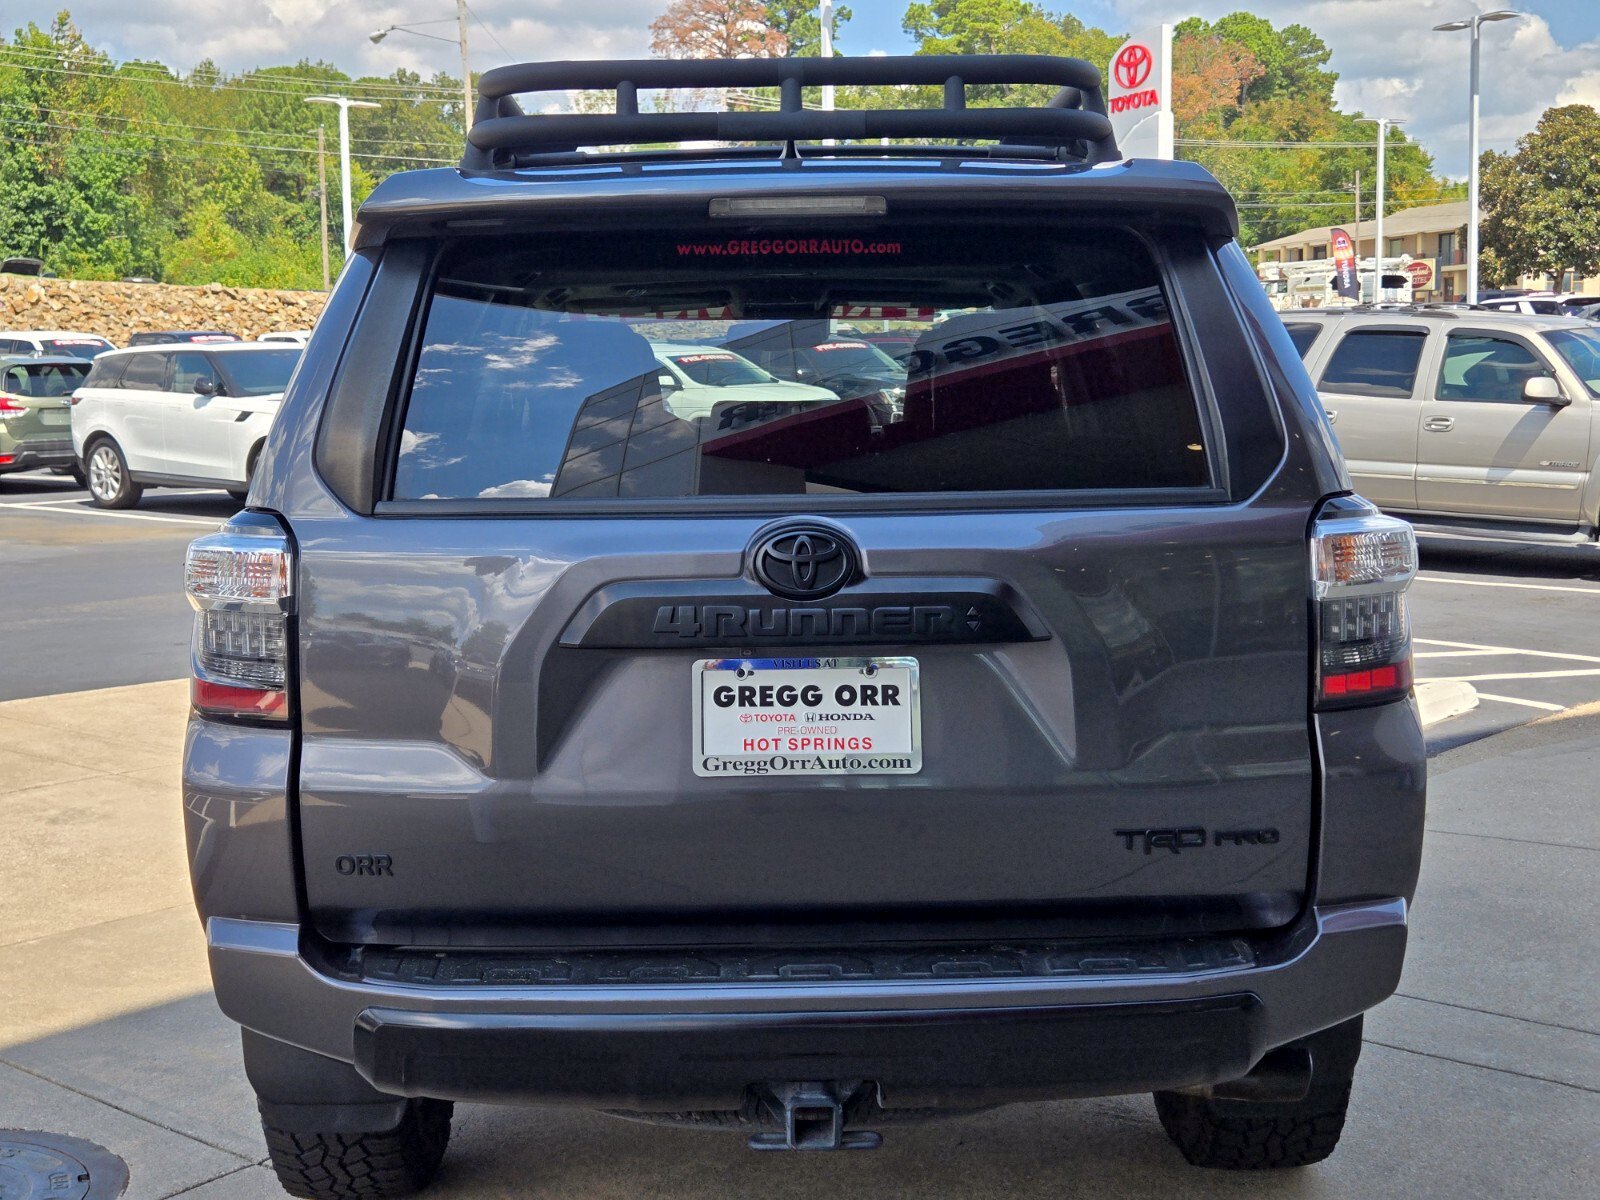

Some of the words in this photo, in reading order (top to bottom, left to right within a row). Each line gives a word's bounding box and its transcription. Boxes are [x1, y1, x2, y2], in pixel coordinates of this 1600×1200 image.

[1108, 89, 1159, 113] TOYOTA
[676, 239, 901, 255] www.GREGGORRAUTO.com
[823, 658, 840, 668] AT
[712, 685, 823, 708] GREGG
[834, 684, 901, 707] ORR
[754, 713, 796, 722] TOYOTA
[818, 712, 876, 721] HONDA
[777, 725, 837, 735] PRE-OWNED
[743, 737, 782, 752] HOT
[788, 737, 873, 751] SPRINGS
[702, 754, 913, 775] GreggOrrAuto.com
[1114, 826, 1206, 855] TRD
[1213, 829, 1280, 847] PRO
[335, 853, 394, 877] ORR
